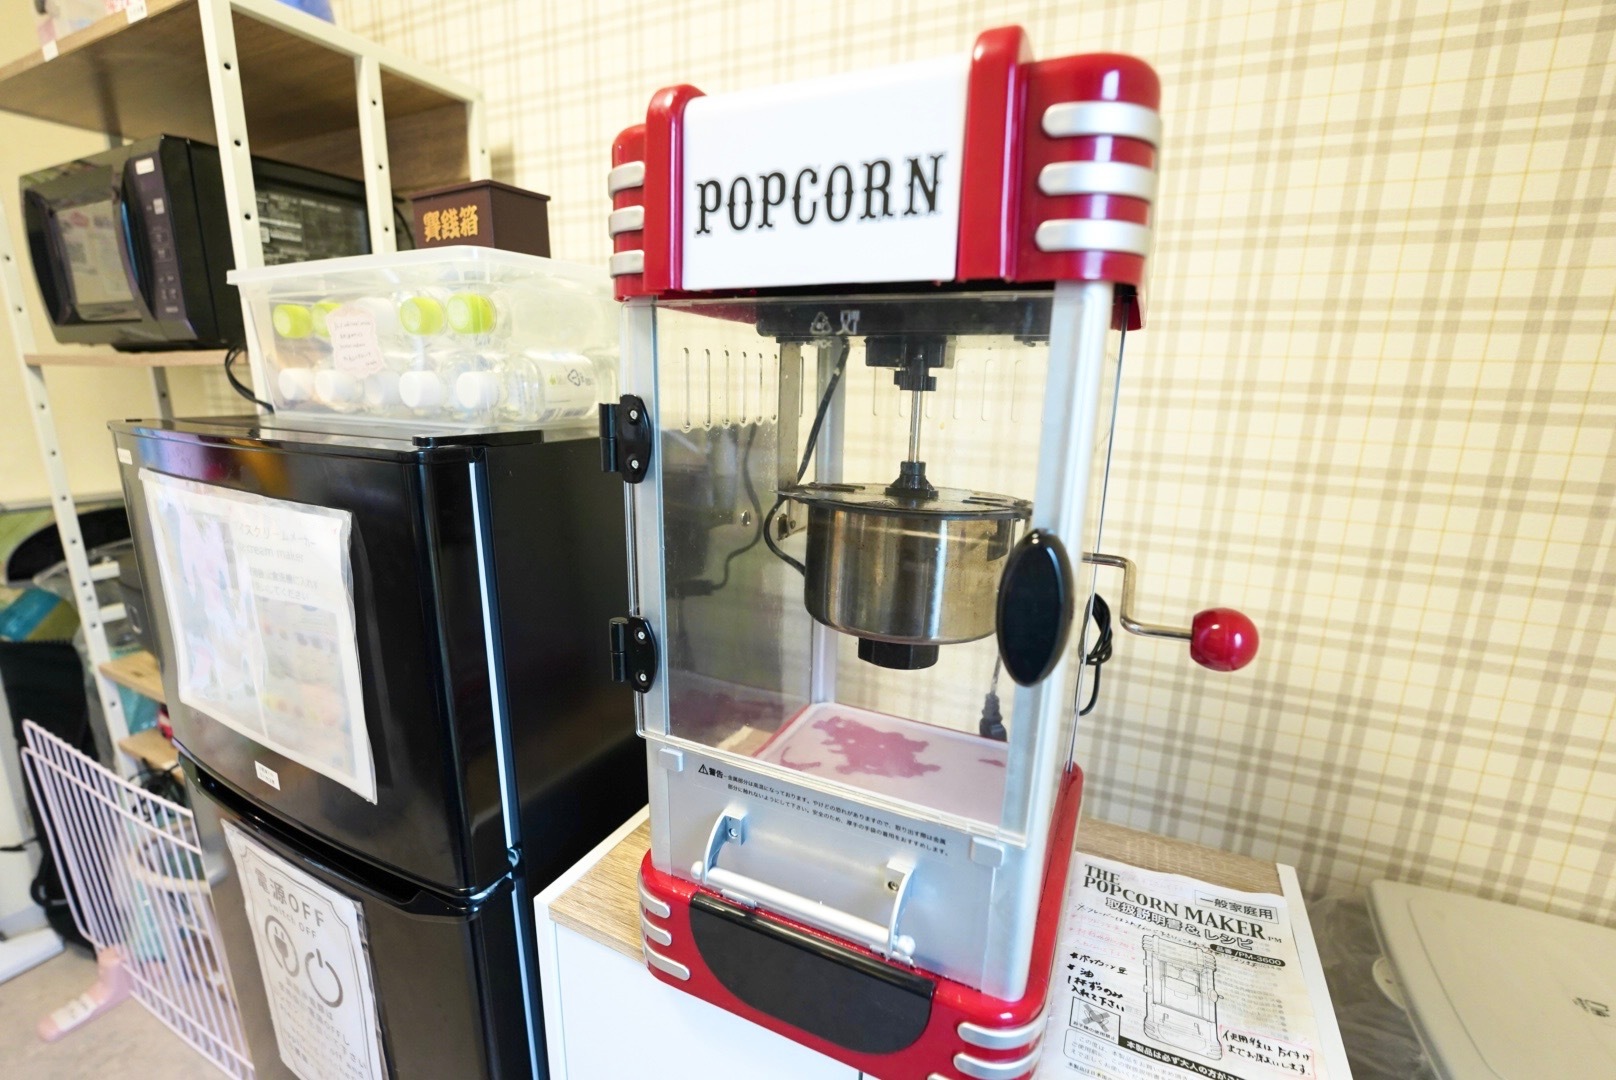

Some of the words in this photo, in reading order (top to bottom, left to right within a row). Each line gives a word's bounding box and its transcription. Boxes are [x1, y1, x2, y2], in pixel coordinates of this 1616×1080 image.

[697, 154, 944, 235] POPCORN
[1085, 864, 1120, 885] THE
[1084, 876, 1179, 917] POPCORN
[1185, 906, 1265, 940] MAKER
[1200, 897, 1273, 920] 一般家庭用
[1205, 928, 1254, 951] レシピ
[1071, 984, 1125, 1012] 入れて下さい
